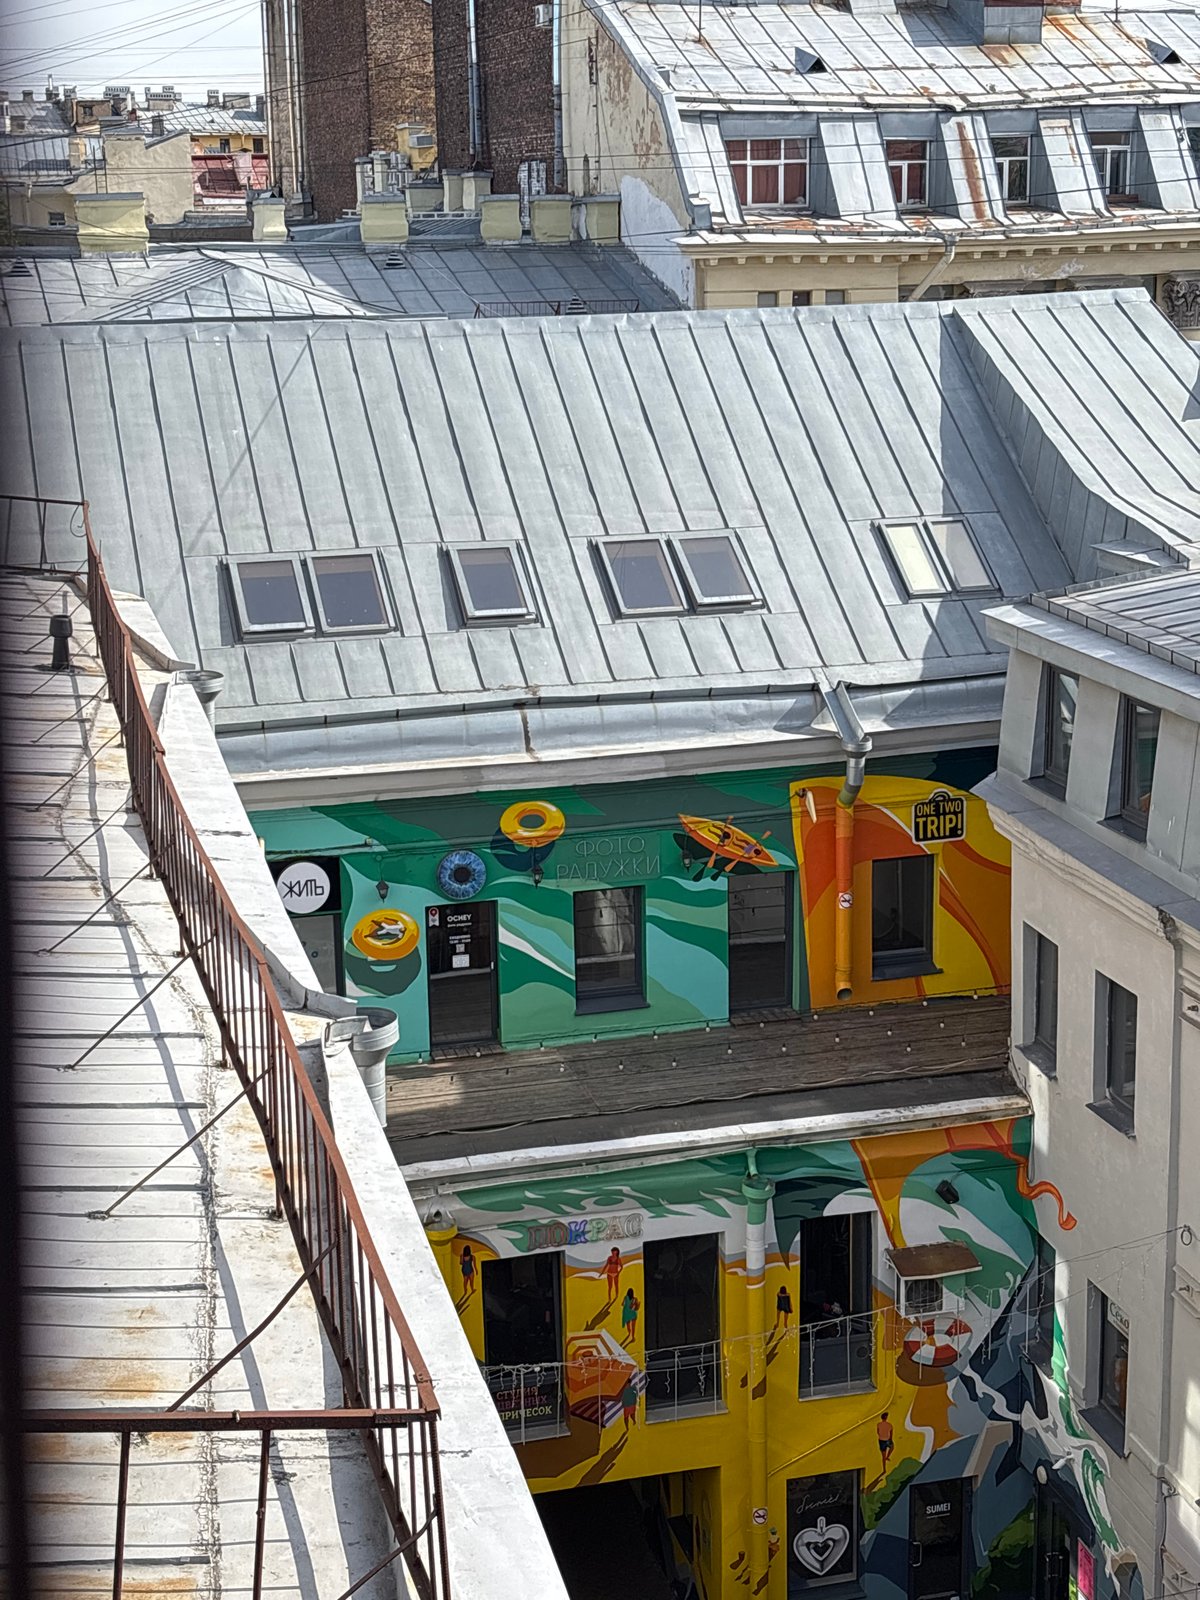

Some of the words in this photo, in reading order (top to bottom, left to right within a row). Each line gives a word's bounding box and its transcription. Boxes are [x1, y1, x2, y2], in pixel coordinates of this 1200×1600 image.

[916, 804, 936, 816] ONE
[939, 801, 962, 813] TWO
[916, 813, 962, 839] TRIP!
[575, 835, 645, 857] ФОТО
[556, 855, 660, 883] РАДУЖКИ
[281, 878, 325, 899] ЖИТЬ
[527, 1213, 643, 1251] ПОКРАС
[926, 1502, 951, 1514] SUMEI
